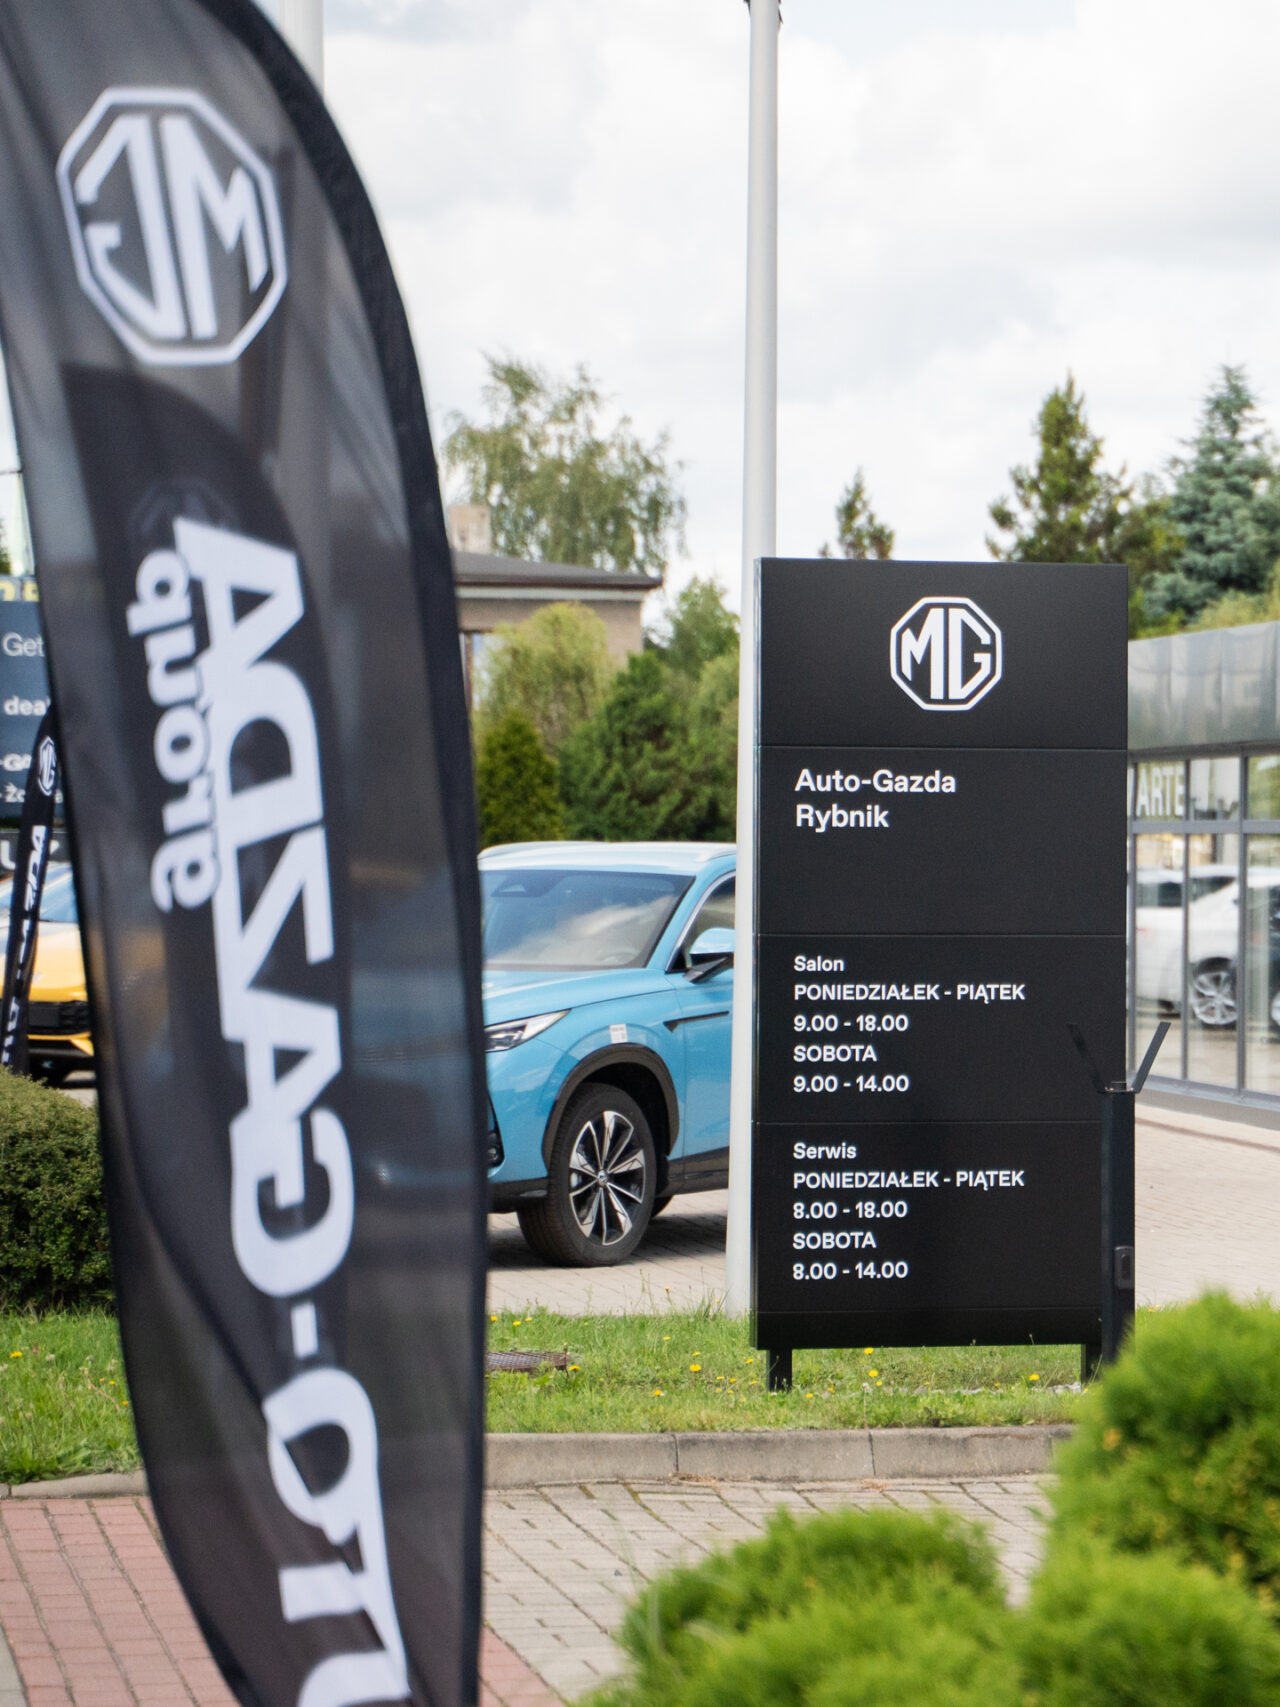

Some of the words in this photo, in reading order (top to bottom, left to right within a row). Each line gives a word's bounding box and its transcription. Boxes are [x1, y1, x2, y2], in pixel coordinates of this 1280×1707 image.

[898, 605, 995, 703] MG
[794, 767, 957, 794] Auto-Gazda
[795, 803, 890, 834] Rybnik
[793, 954, 845, 973] Salon
[794, 983, 940, 1002] PONIEDZIAŁEK
[956, 983, 1026, 1005] PIĄTEK
[793, 1014, 839, 1032] 9.00
[856, 1014, 909, 1033] 18.00
[793, 1044, 878, 1063] SOBOTA
[793, 1074, 839, 1093] 9.00
[856, 1074, 910, 1093] 14.00
[793, 1141, 857, 1160] Serwis
[793, 1170, 939, 1189] PONIEDZIAŁEK
[955, 1170, 1025, 1192] PIĄTEK
[793, 1201, 838, 1220] 8.00
[855, 1200, 908, 1219] 18.00
[793, 1231, 877, 1250] SOBOTA
[793, 1262, 838, 1281] 8.00
[854, 1260, 909, 1280] 14.00
